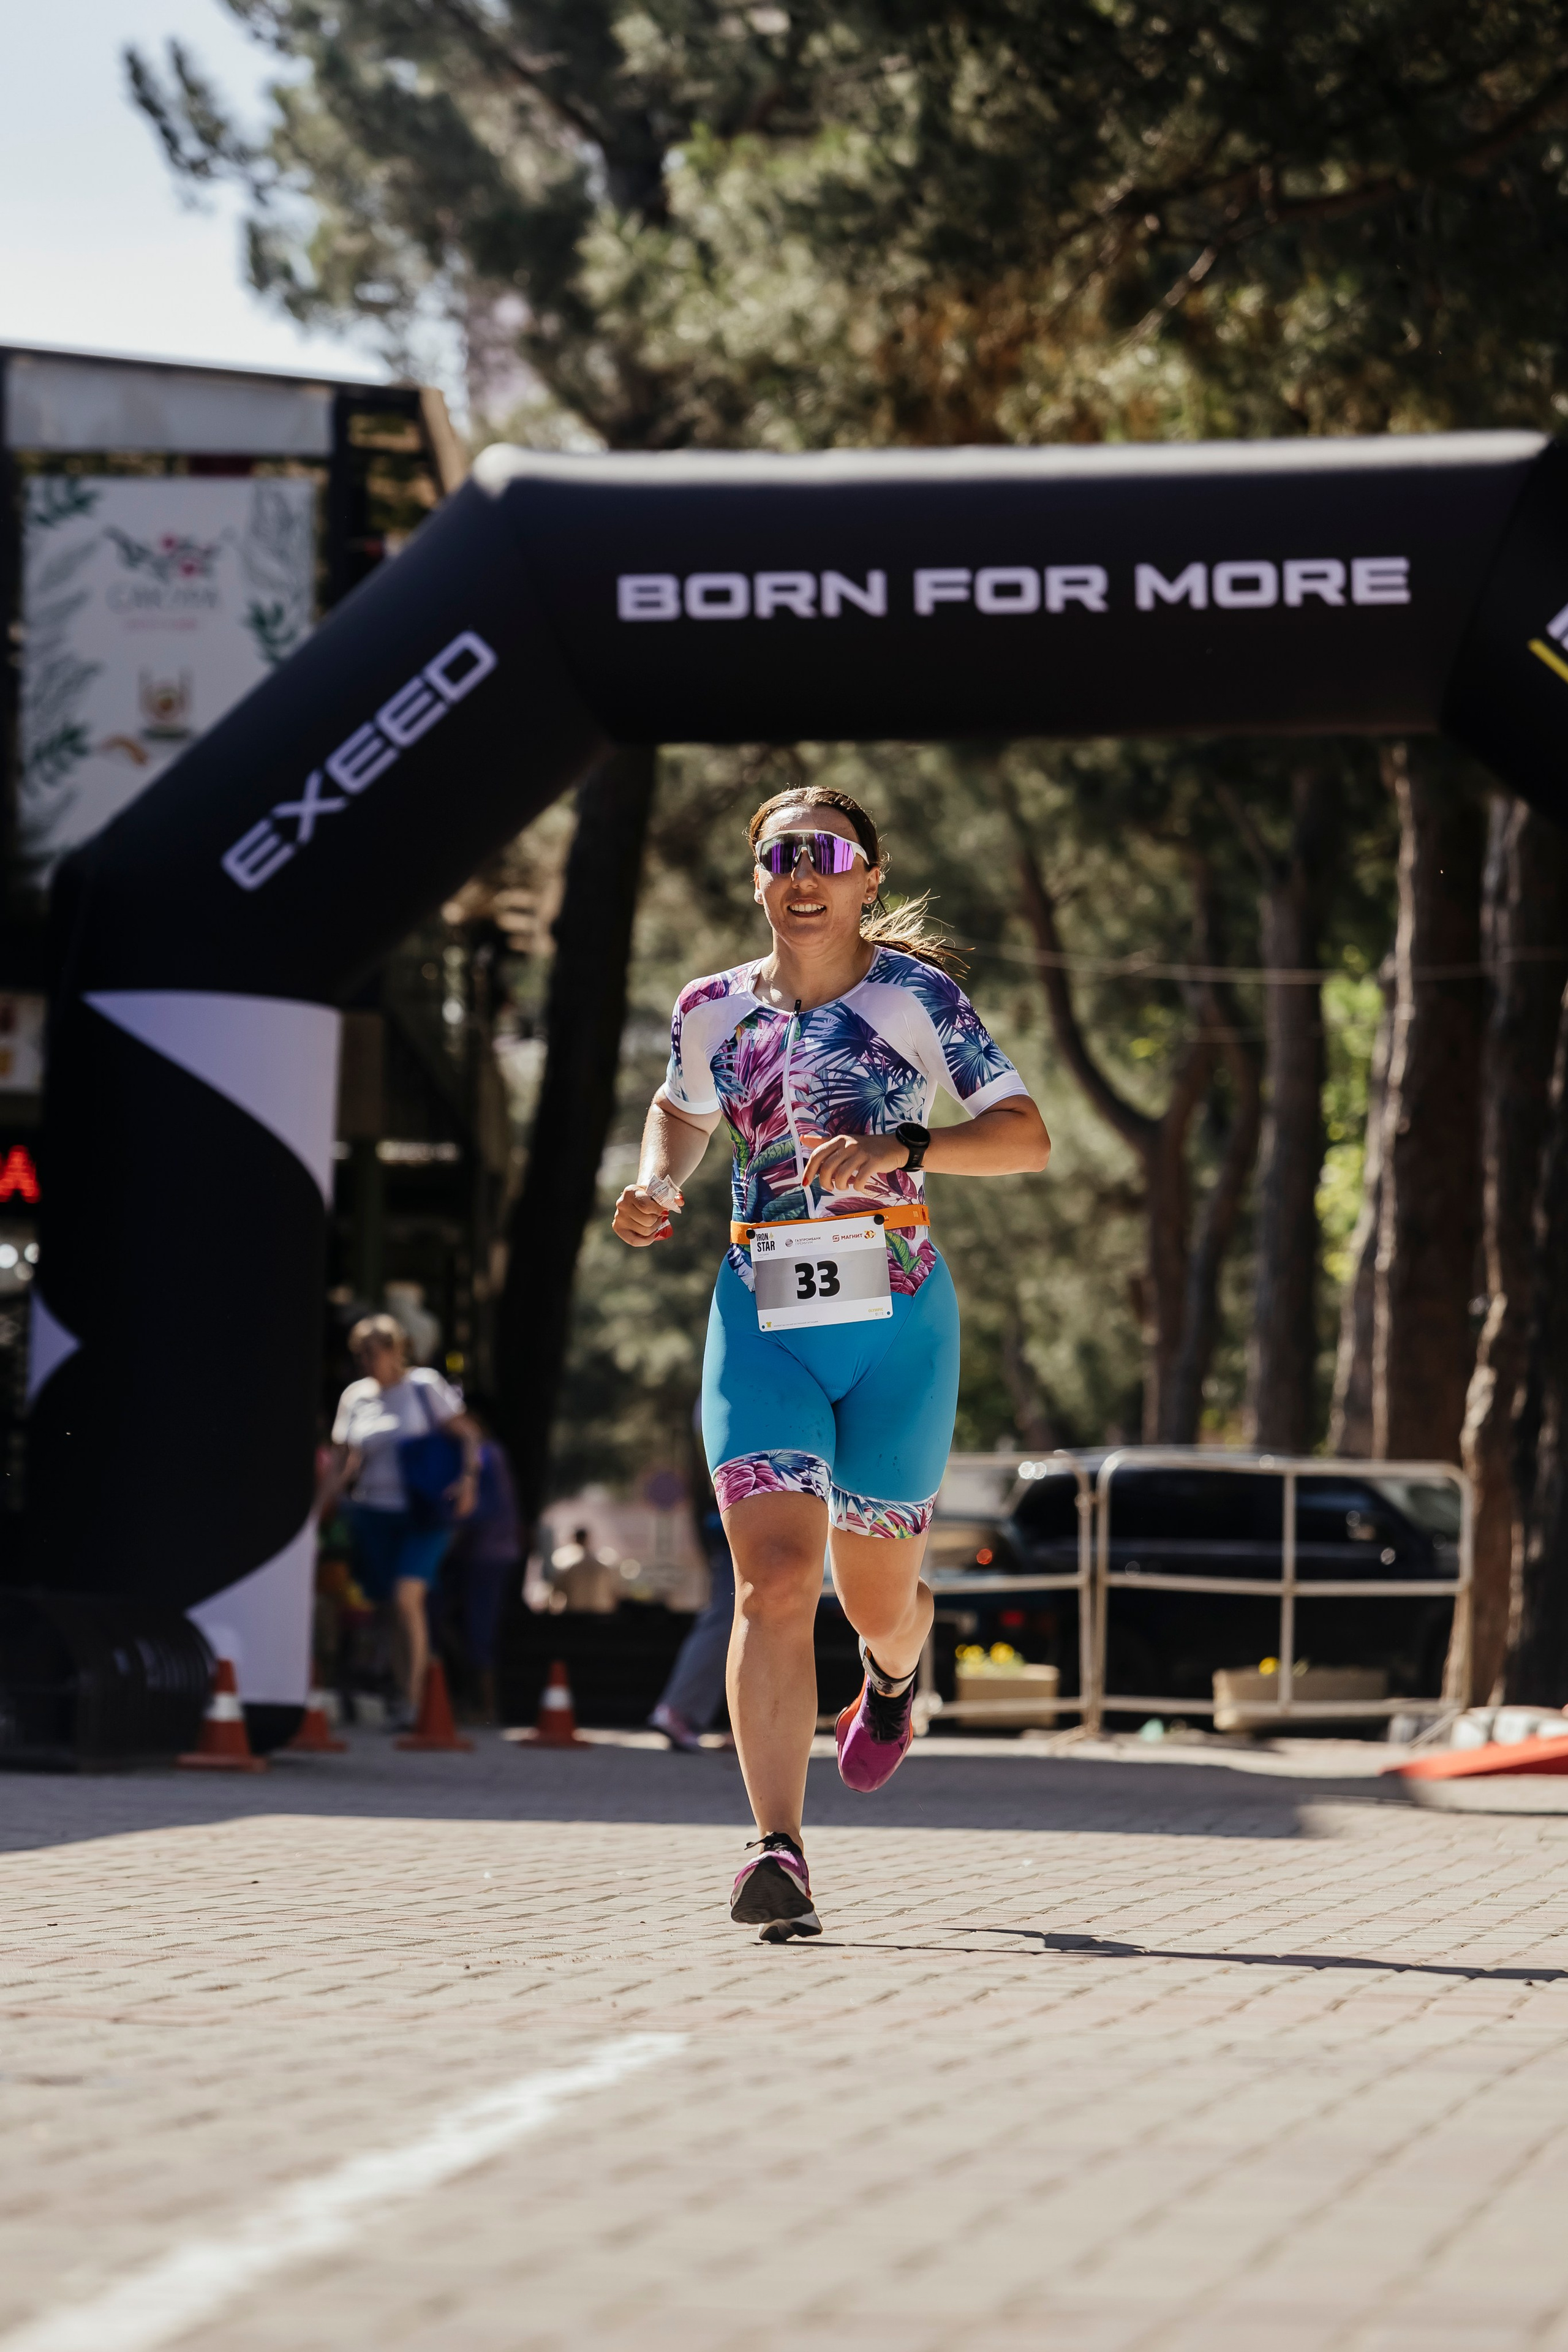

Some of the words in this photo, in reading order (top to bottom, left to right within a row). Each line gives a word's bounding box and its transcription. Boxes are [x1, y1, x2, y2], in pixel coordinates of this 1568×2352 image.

[617, 571, 887, 620] BORN
[913, 565, 1108, 616] FOR
[1134, 556, 1411, 611] MORE
[222, 631, 497, 889] EXEED
[756, 1232, 769, 1242] IRON
[757, 1240, 775, 1252] STAR
[794, 1260, 840, 1300] 33
